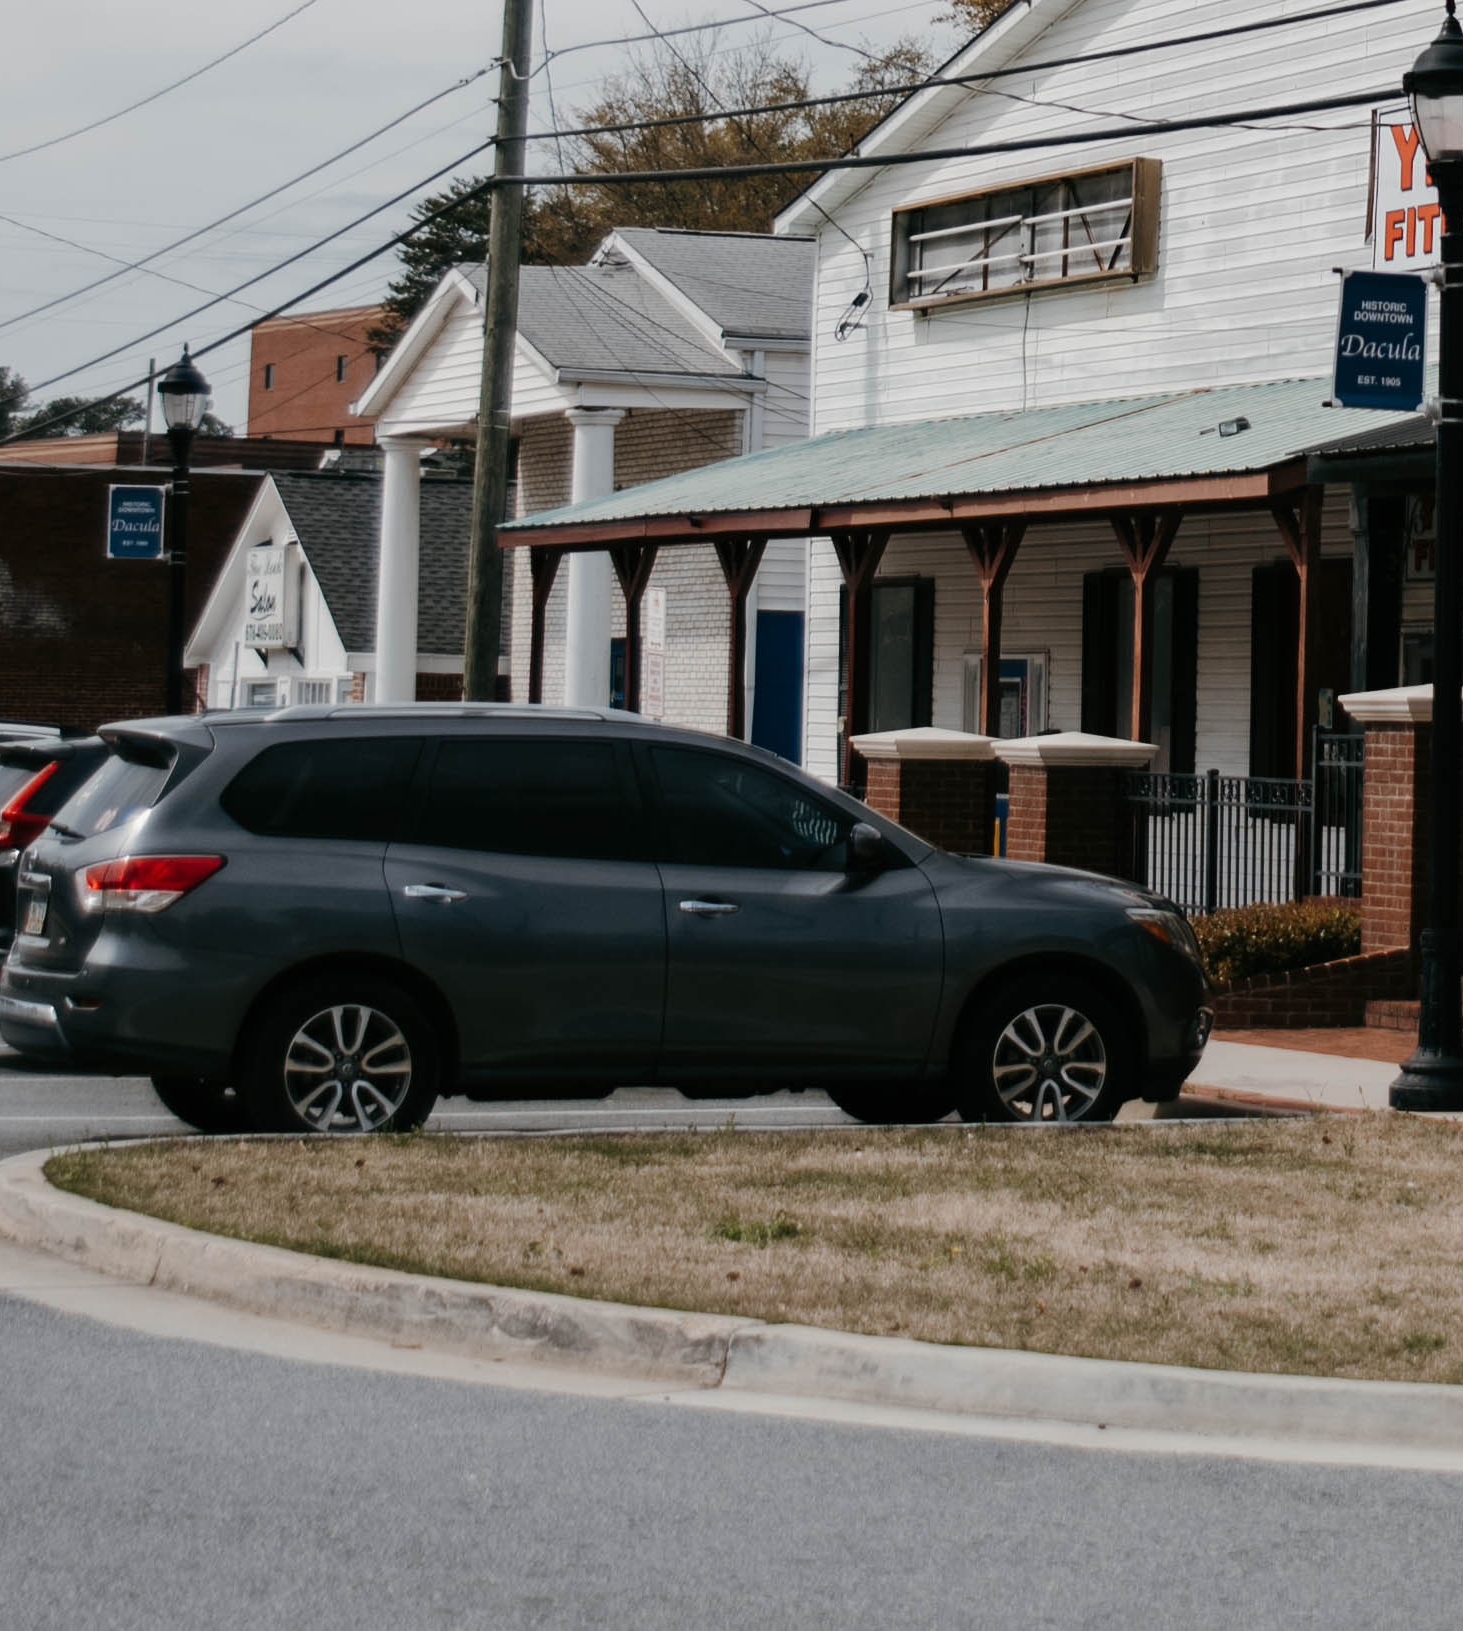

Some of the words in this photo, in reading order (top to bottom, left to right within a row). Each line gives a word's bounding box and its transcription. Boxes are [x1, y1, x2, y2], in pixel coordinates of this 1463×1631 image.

[1361, 300, 1407, 313] HISTORIC
[1353, 310, 1413, 324] DOWNTOWN
[1341, 332, 1421, 361] Dacula
[1357, 374, 1378, 385] EST.
[1381, 376, 1401, 387] 1905
[112, 517, 160, 532] Dacula
[249, 579, 276, 614] Salon
